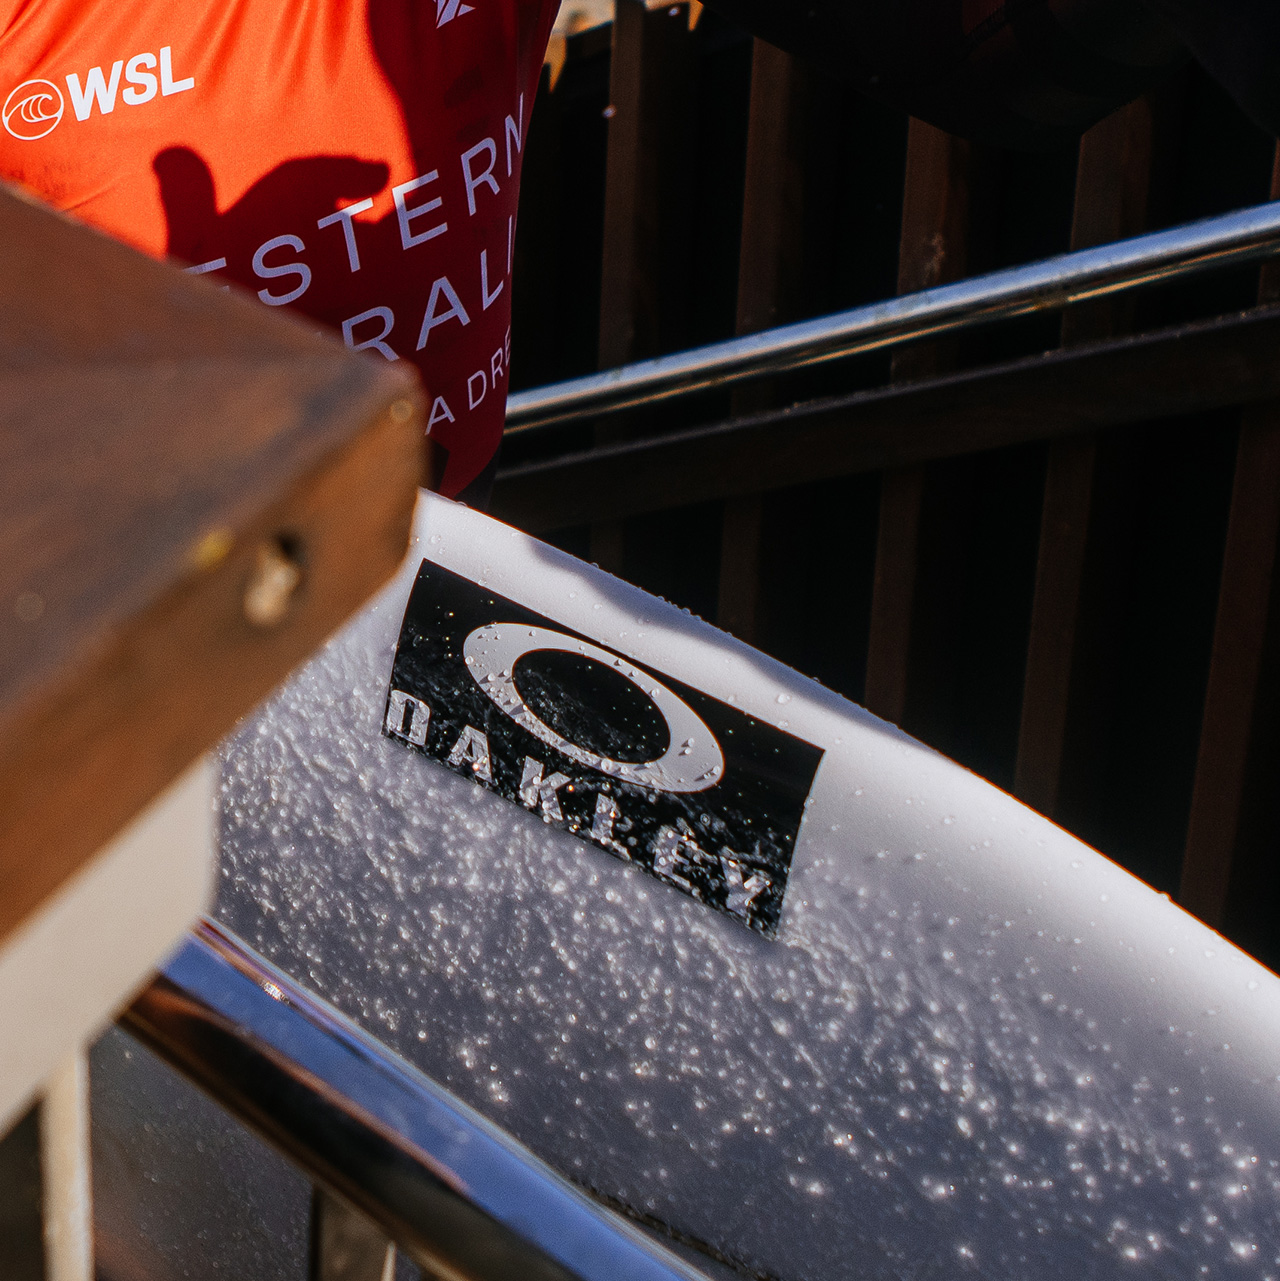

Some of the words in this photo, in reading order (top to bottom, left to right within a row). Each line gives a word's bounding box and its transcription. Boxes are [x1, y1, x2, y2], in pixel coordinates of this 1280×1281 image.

[65, 45, 195, 122] WSL
[340, 214, 513, 362] RALI
[424, 395, 456, 436] A
